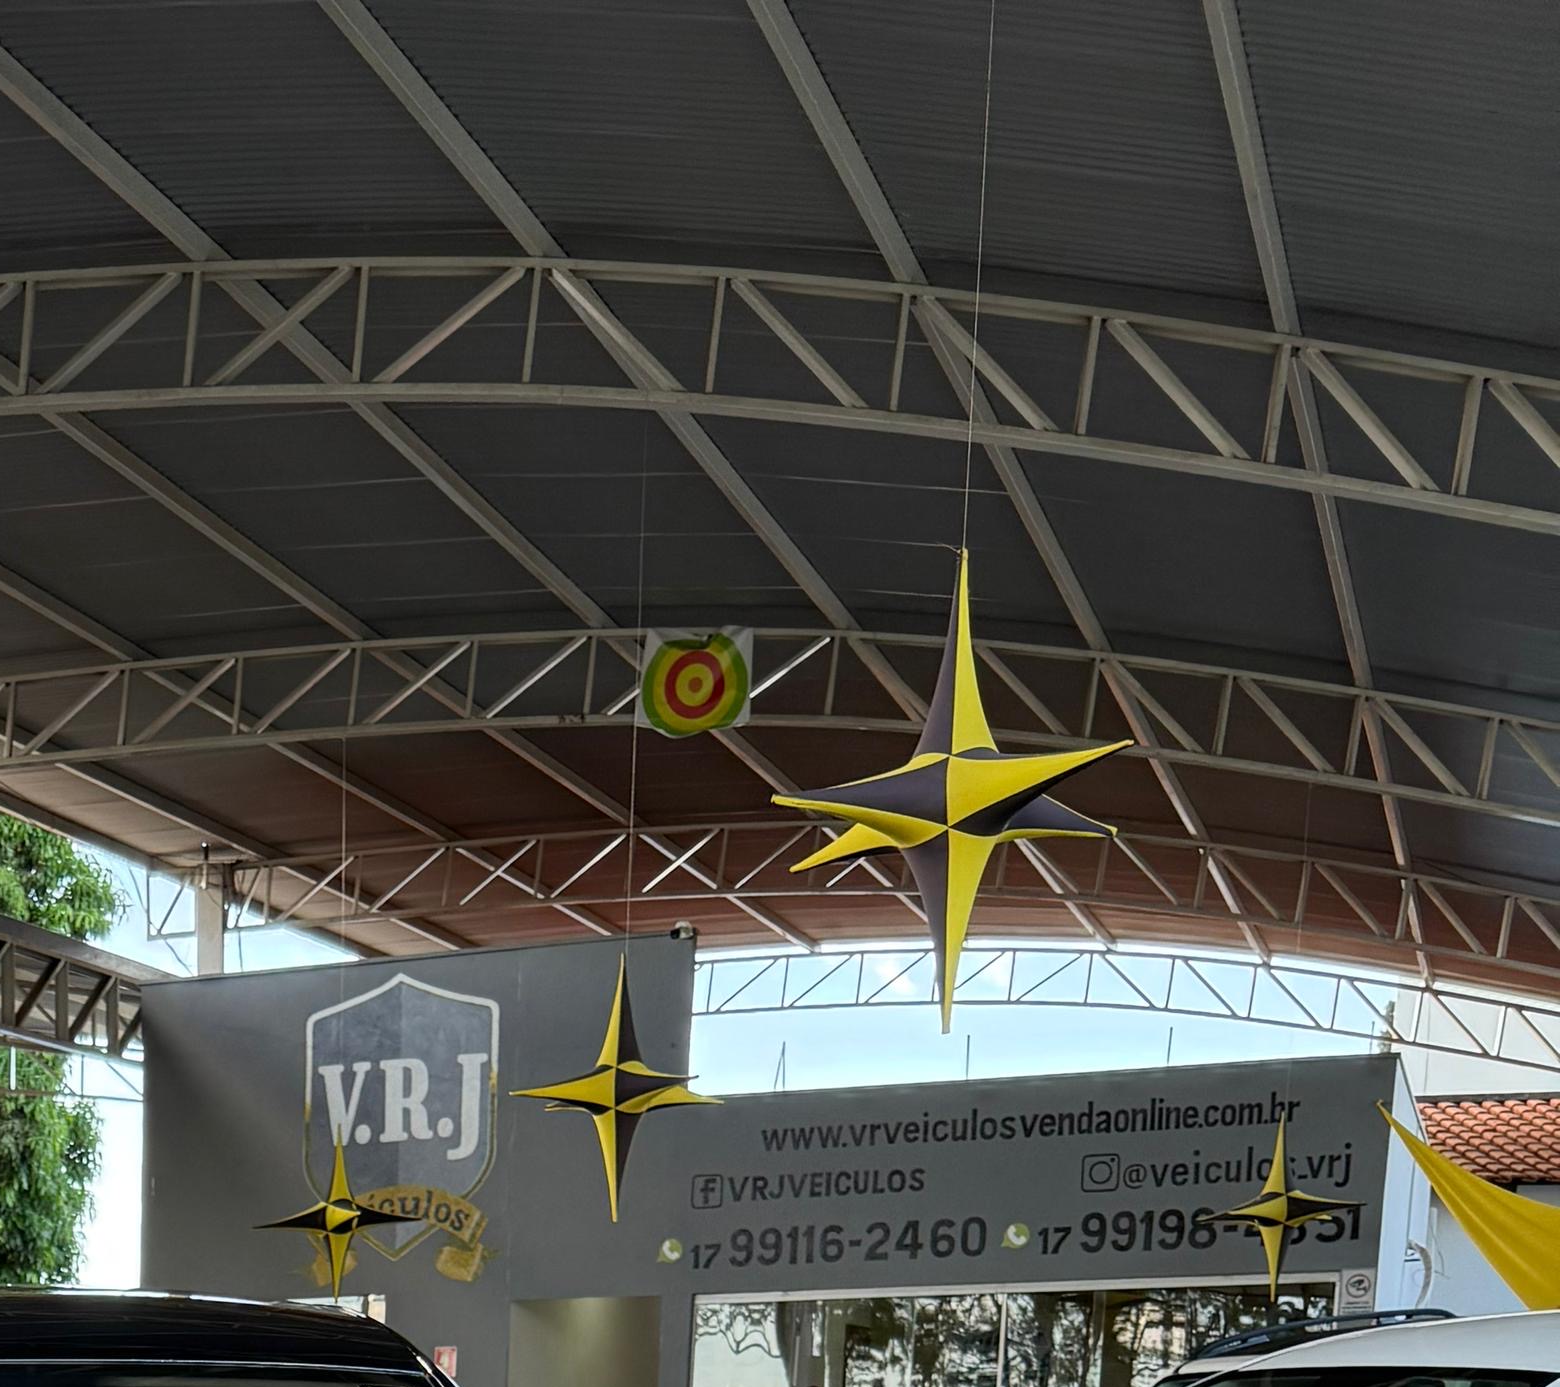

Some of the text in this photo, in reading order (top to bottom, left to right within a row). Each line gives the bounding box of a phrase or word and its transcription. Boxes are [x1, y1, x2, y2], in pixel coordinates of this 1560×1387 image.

[318, 1053, 489, 1161] V.R.J
[727, 1168, 926, 1202] VRJVEICULOS
[689, 1216, 988, 1270] 17 99116-2460
[1037, 1226, 1072, 1256] 17
